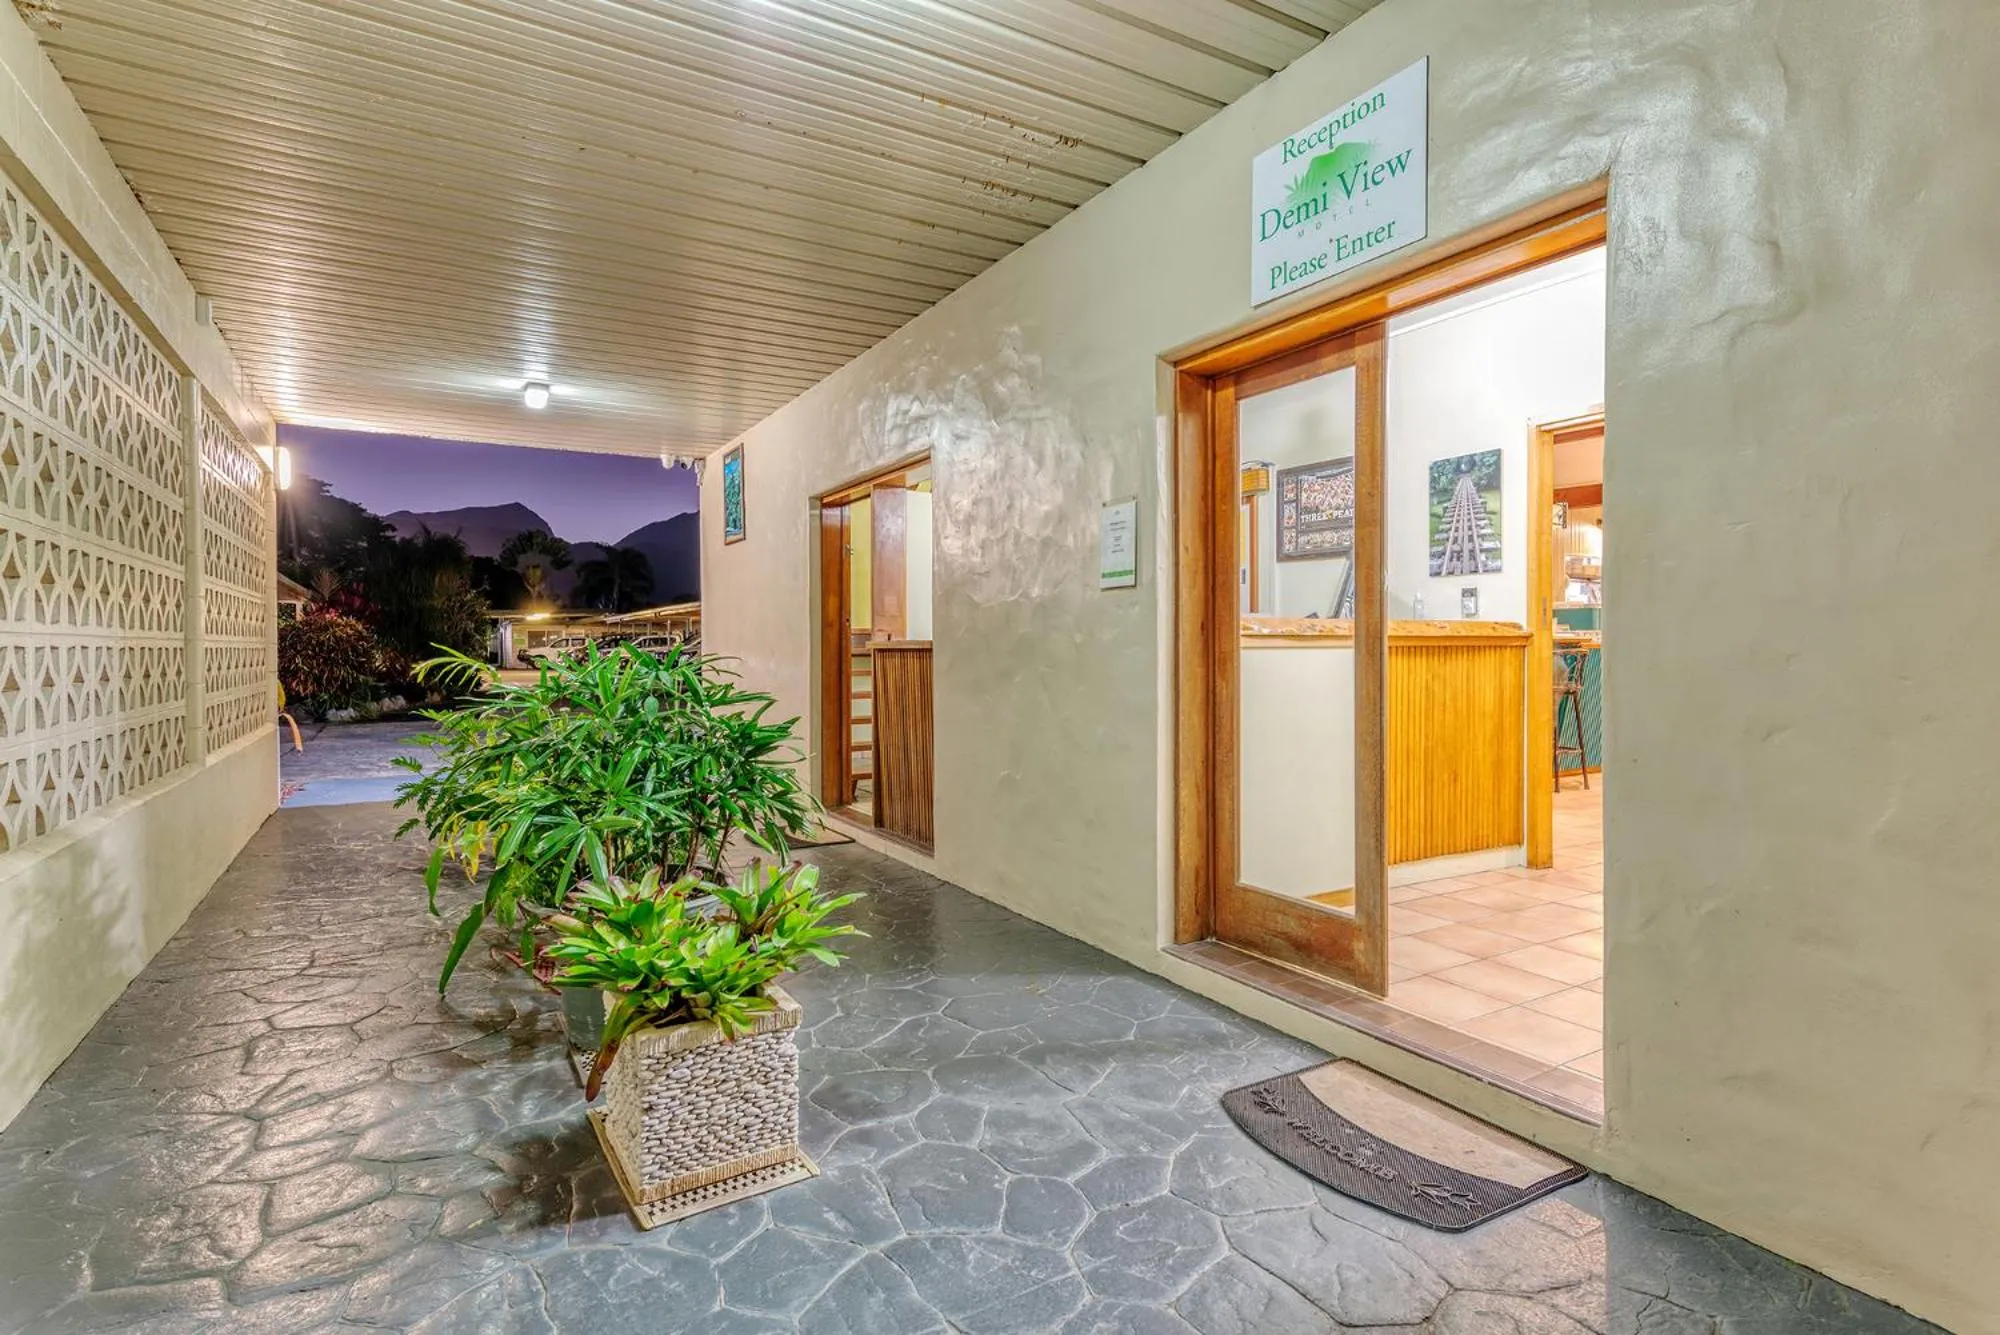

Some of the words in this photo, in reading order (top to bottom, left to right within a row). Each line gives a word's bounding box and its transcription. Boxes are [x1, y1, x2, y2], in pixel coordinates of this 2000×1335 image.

[1282, 91, 1386, 164] Reception
[1259, 181, 1330, 243] Demi
[1337, 148, 1413, 200] View
[1270, 252, 1328, 290] Please
[1335, 220, 1396, 262] Enter
[1301, 511, 1327, 522] THREE
